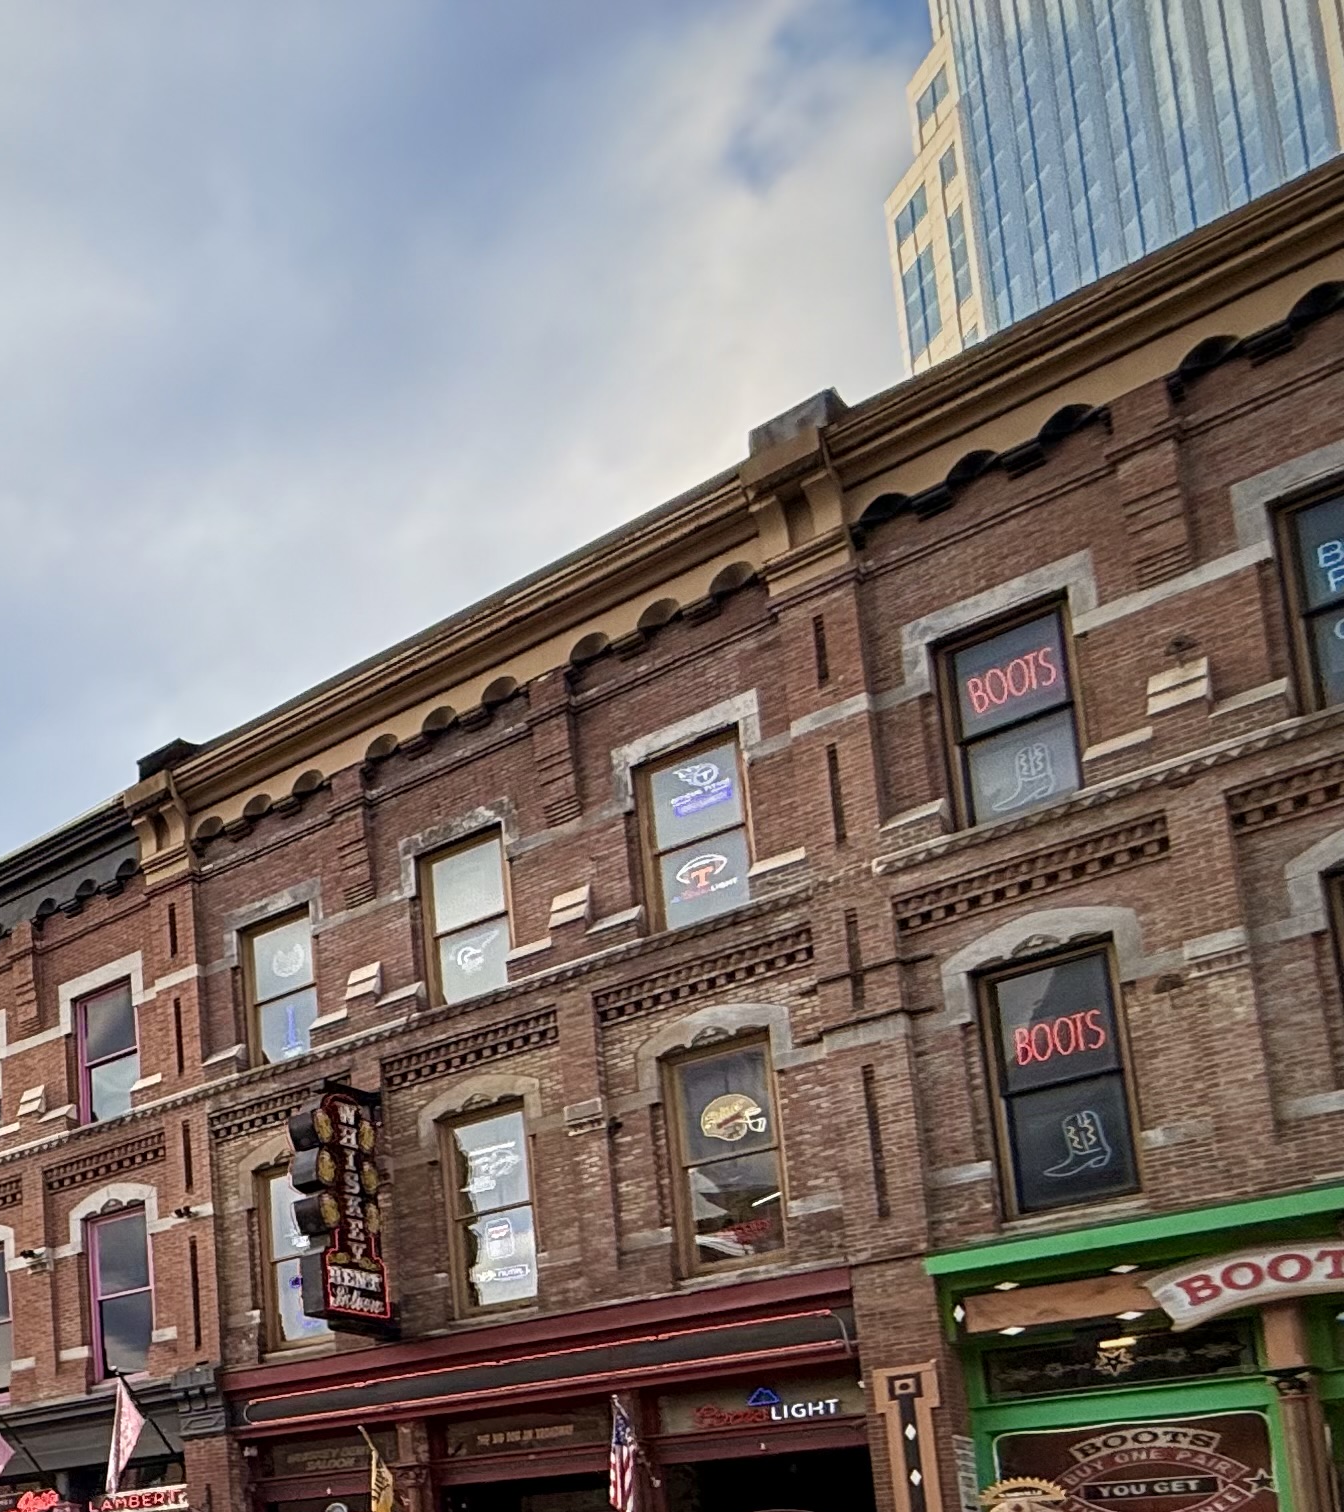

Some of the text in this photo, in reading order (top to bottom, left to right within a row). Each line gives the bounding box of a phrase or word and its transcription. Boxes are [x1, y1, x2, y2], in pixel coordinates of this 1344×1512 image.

[967, 647, 1056, 713] BOOTS
[1014, 1009, 1106, 1066] BOOTS
[771, 1398, 840, 1421] LIGHT
[1073, 1428, 1212, 1459] BOOTS
[1065, 1448, 1234, 1487] BUY ONE PAIR
[1099, 1479, 1201, 1498] YOU GET
